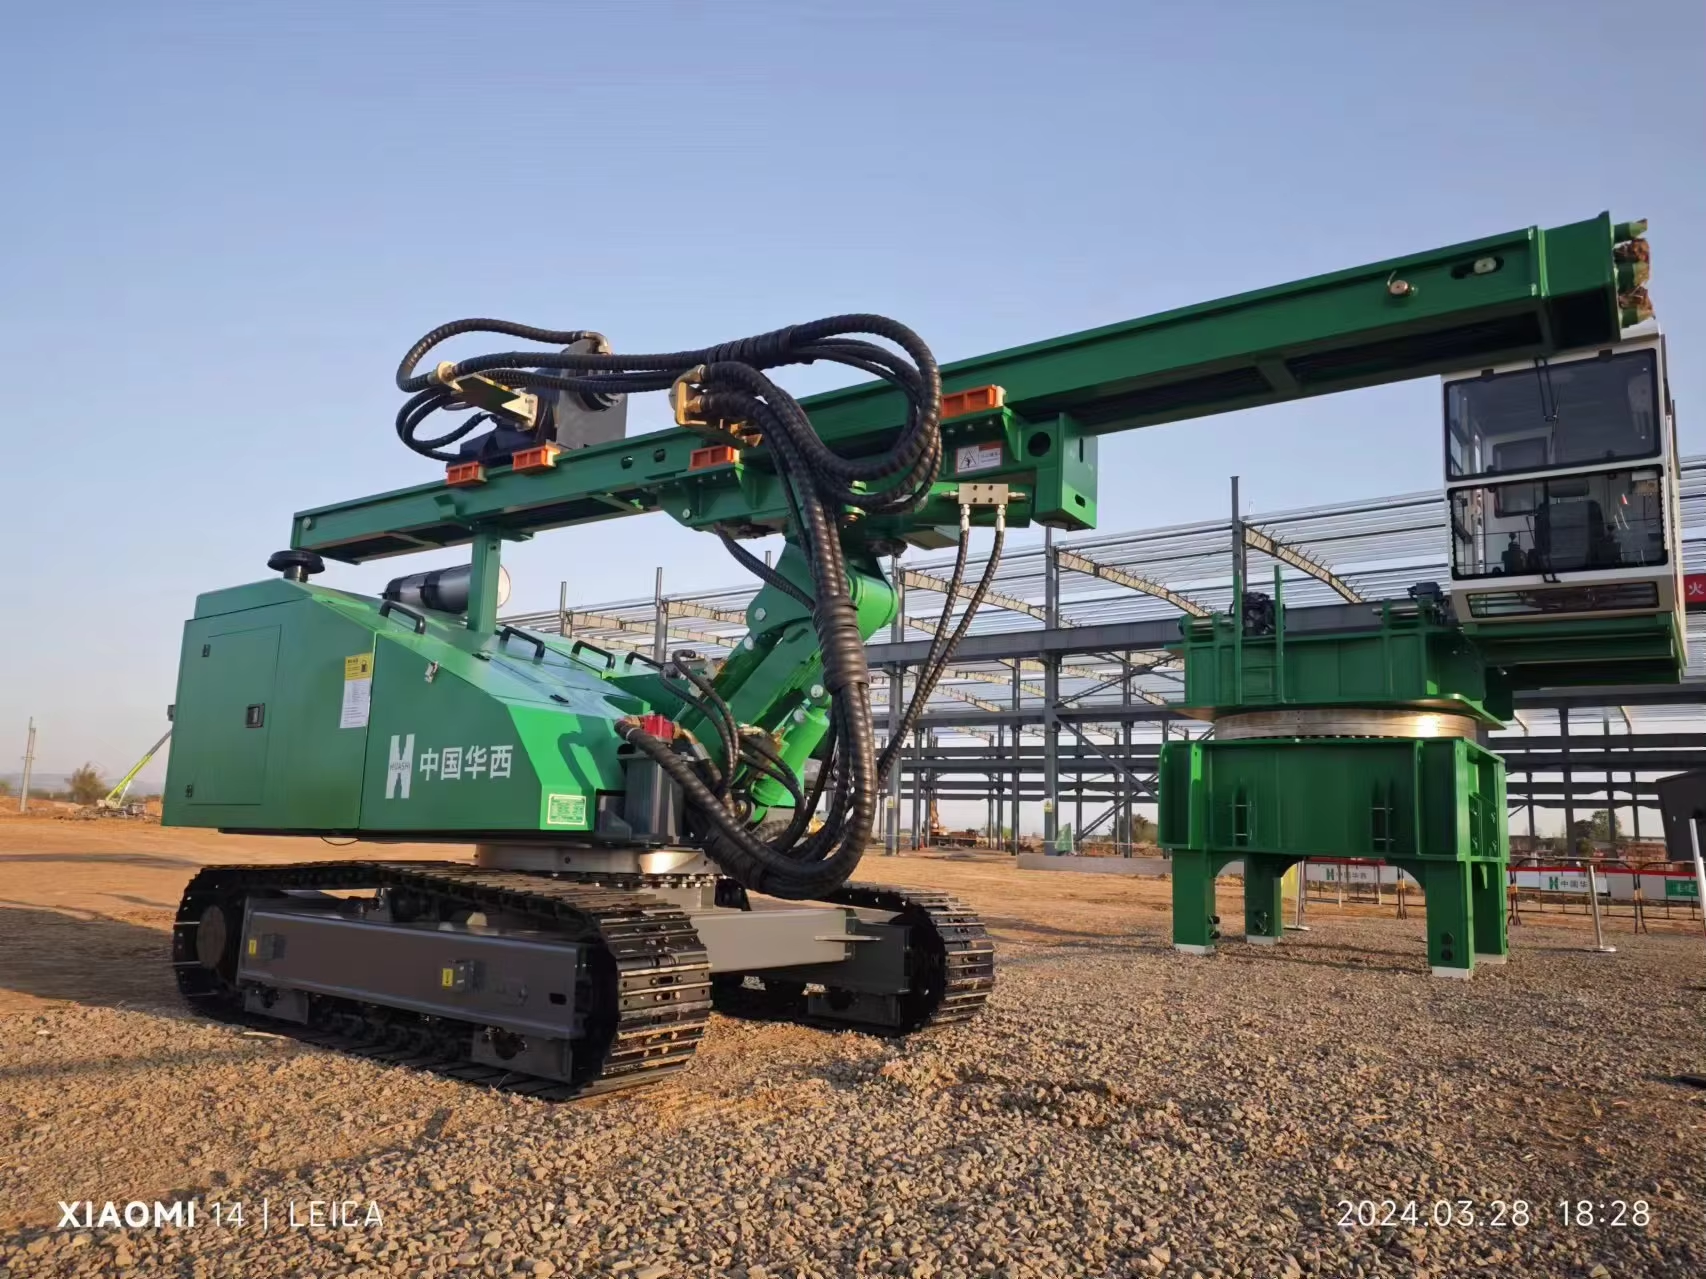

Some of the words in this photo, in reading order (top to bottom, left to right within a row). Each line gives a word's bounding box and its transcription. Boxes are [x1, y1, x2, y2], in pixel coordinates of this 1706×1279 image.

[1688, 582, 1705, 596] 火
[419, 745, 513, 781] 中国华西
[1560, 880, 1592, 889] 中国华
